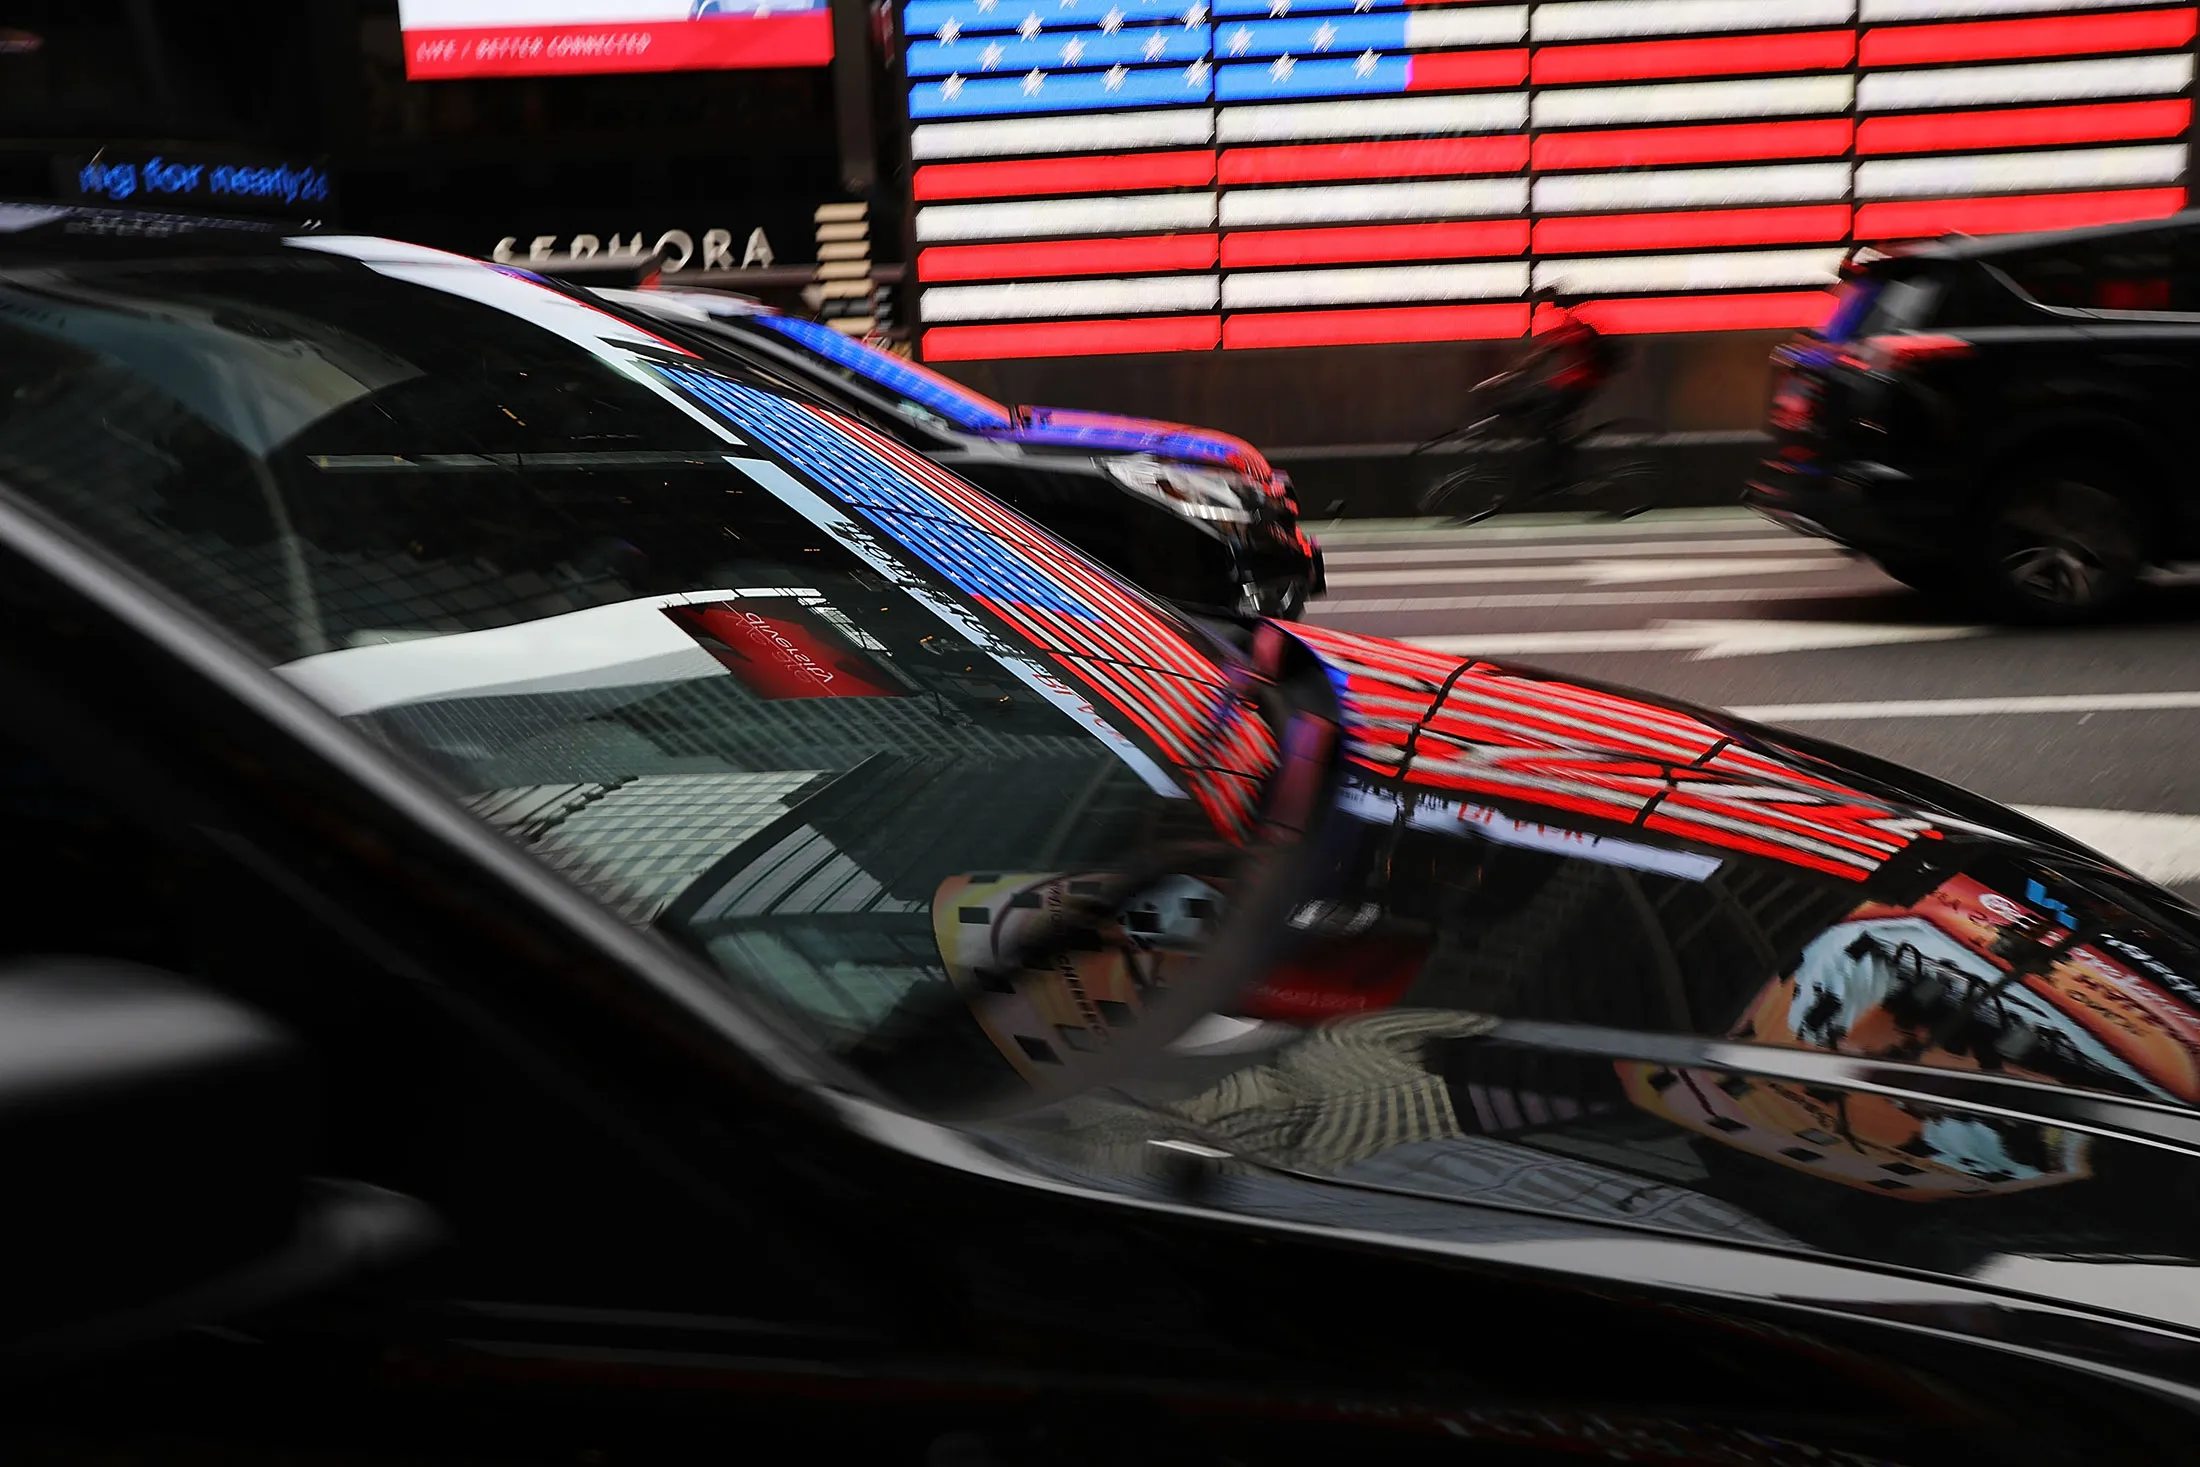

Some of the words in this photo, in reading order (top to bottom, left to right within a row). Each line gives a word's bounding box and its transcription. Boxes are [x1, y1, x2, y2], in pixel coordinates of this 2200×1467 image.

[416, 38, 458, 62] LIFE
[475, 36, 544, 60] BETTER
[546, 32, 652, 58] CONNECTED
[141, 155, 206, 193] for
